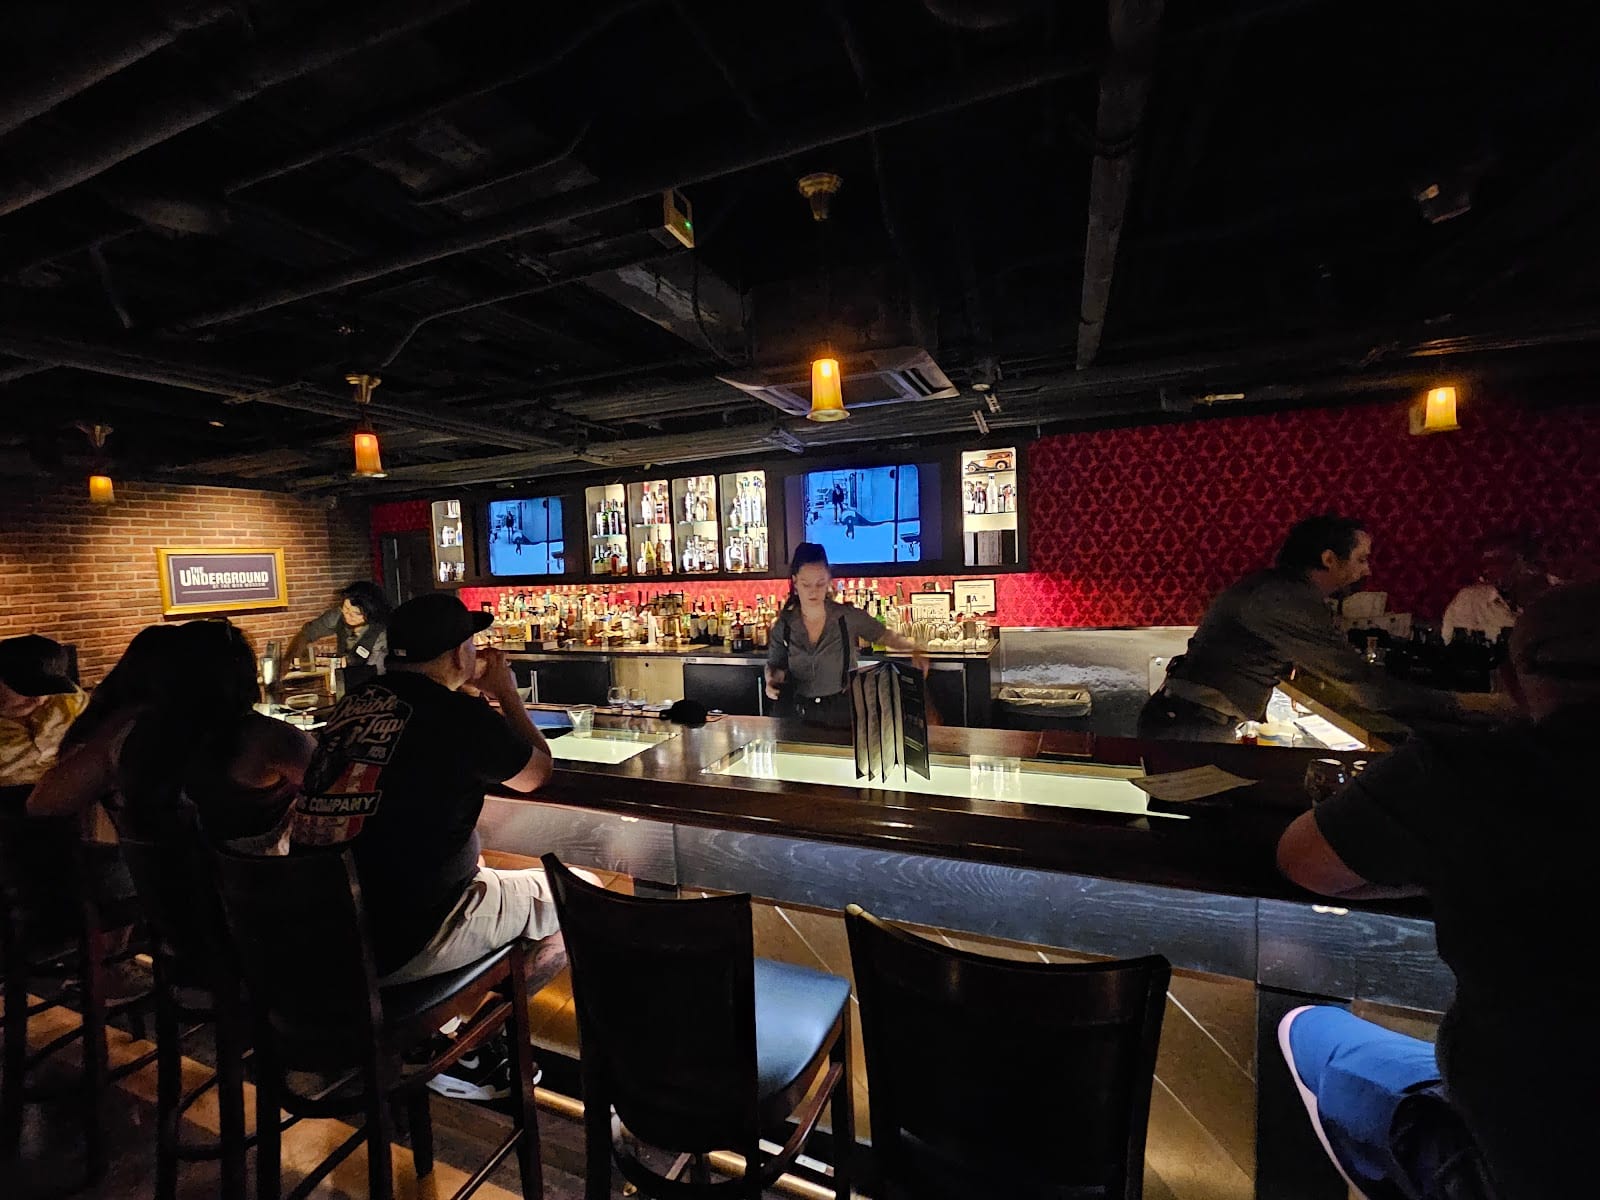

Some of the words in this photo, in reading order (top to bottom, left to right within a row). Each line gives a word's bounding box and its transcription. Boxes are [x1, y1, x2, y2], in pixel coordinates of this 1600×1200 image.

[180, 569, 269, 586] UNDERGROUND
[189, 566, 204, 574] THE
[309, 796, 377, 812] COMPANY
